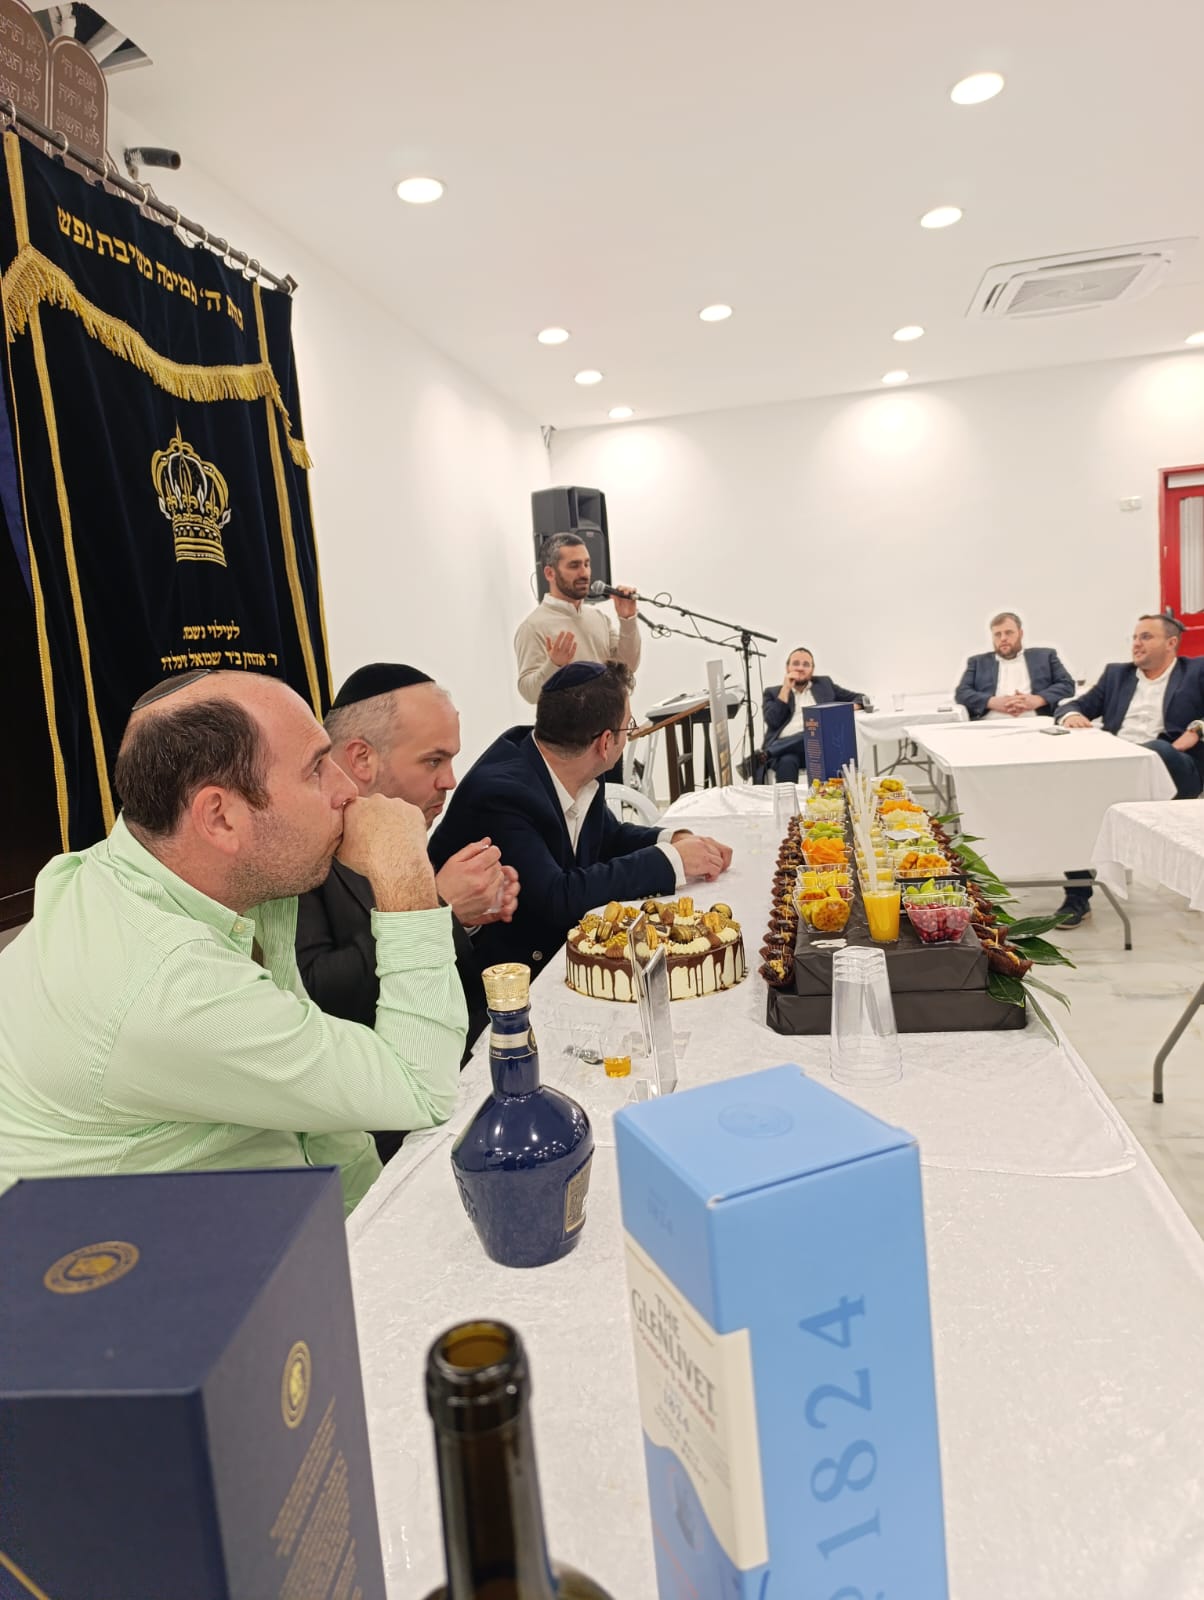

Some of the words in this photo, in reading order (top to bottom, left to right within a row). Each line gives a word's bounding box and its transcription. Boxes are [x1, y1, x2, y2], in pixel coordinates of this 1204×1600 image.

[57, 205, 94, 250] נפש
[96, 229, 153, 281] משיבת
[156, 260, 198, 306] תמימה
[207, 619, 240, 640] לעילוי
[655, 1293, 681, 1341] THE
[797, 1293, 881, 1561] 1824
